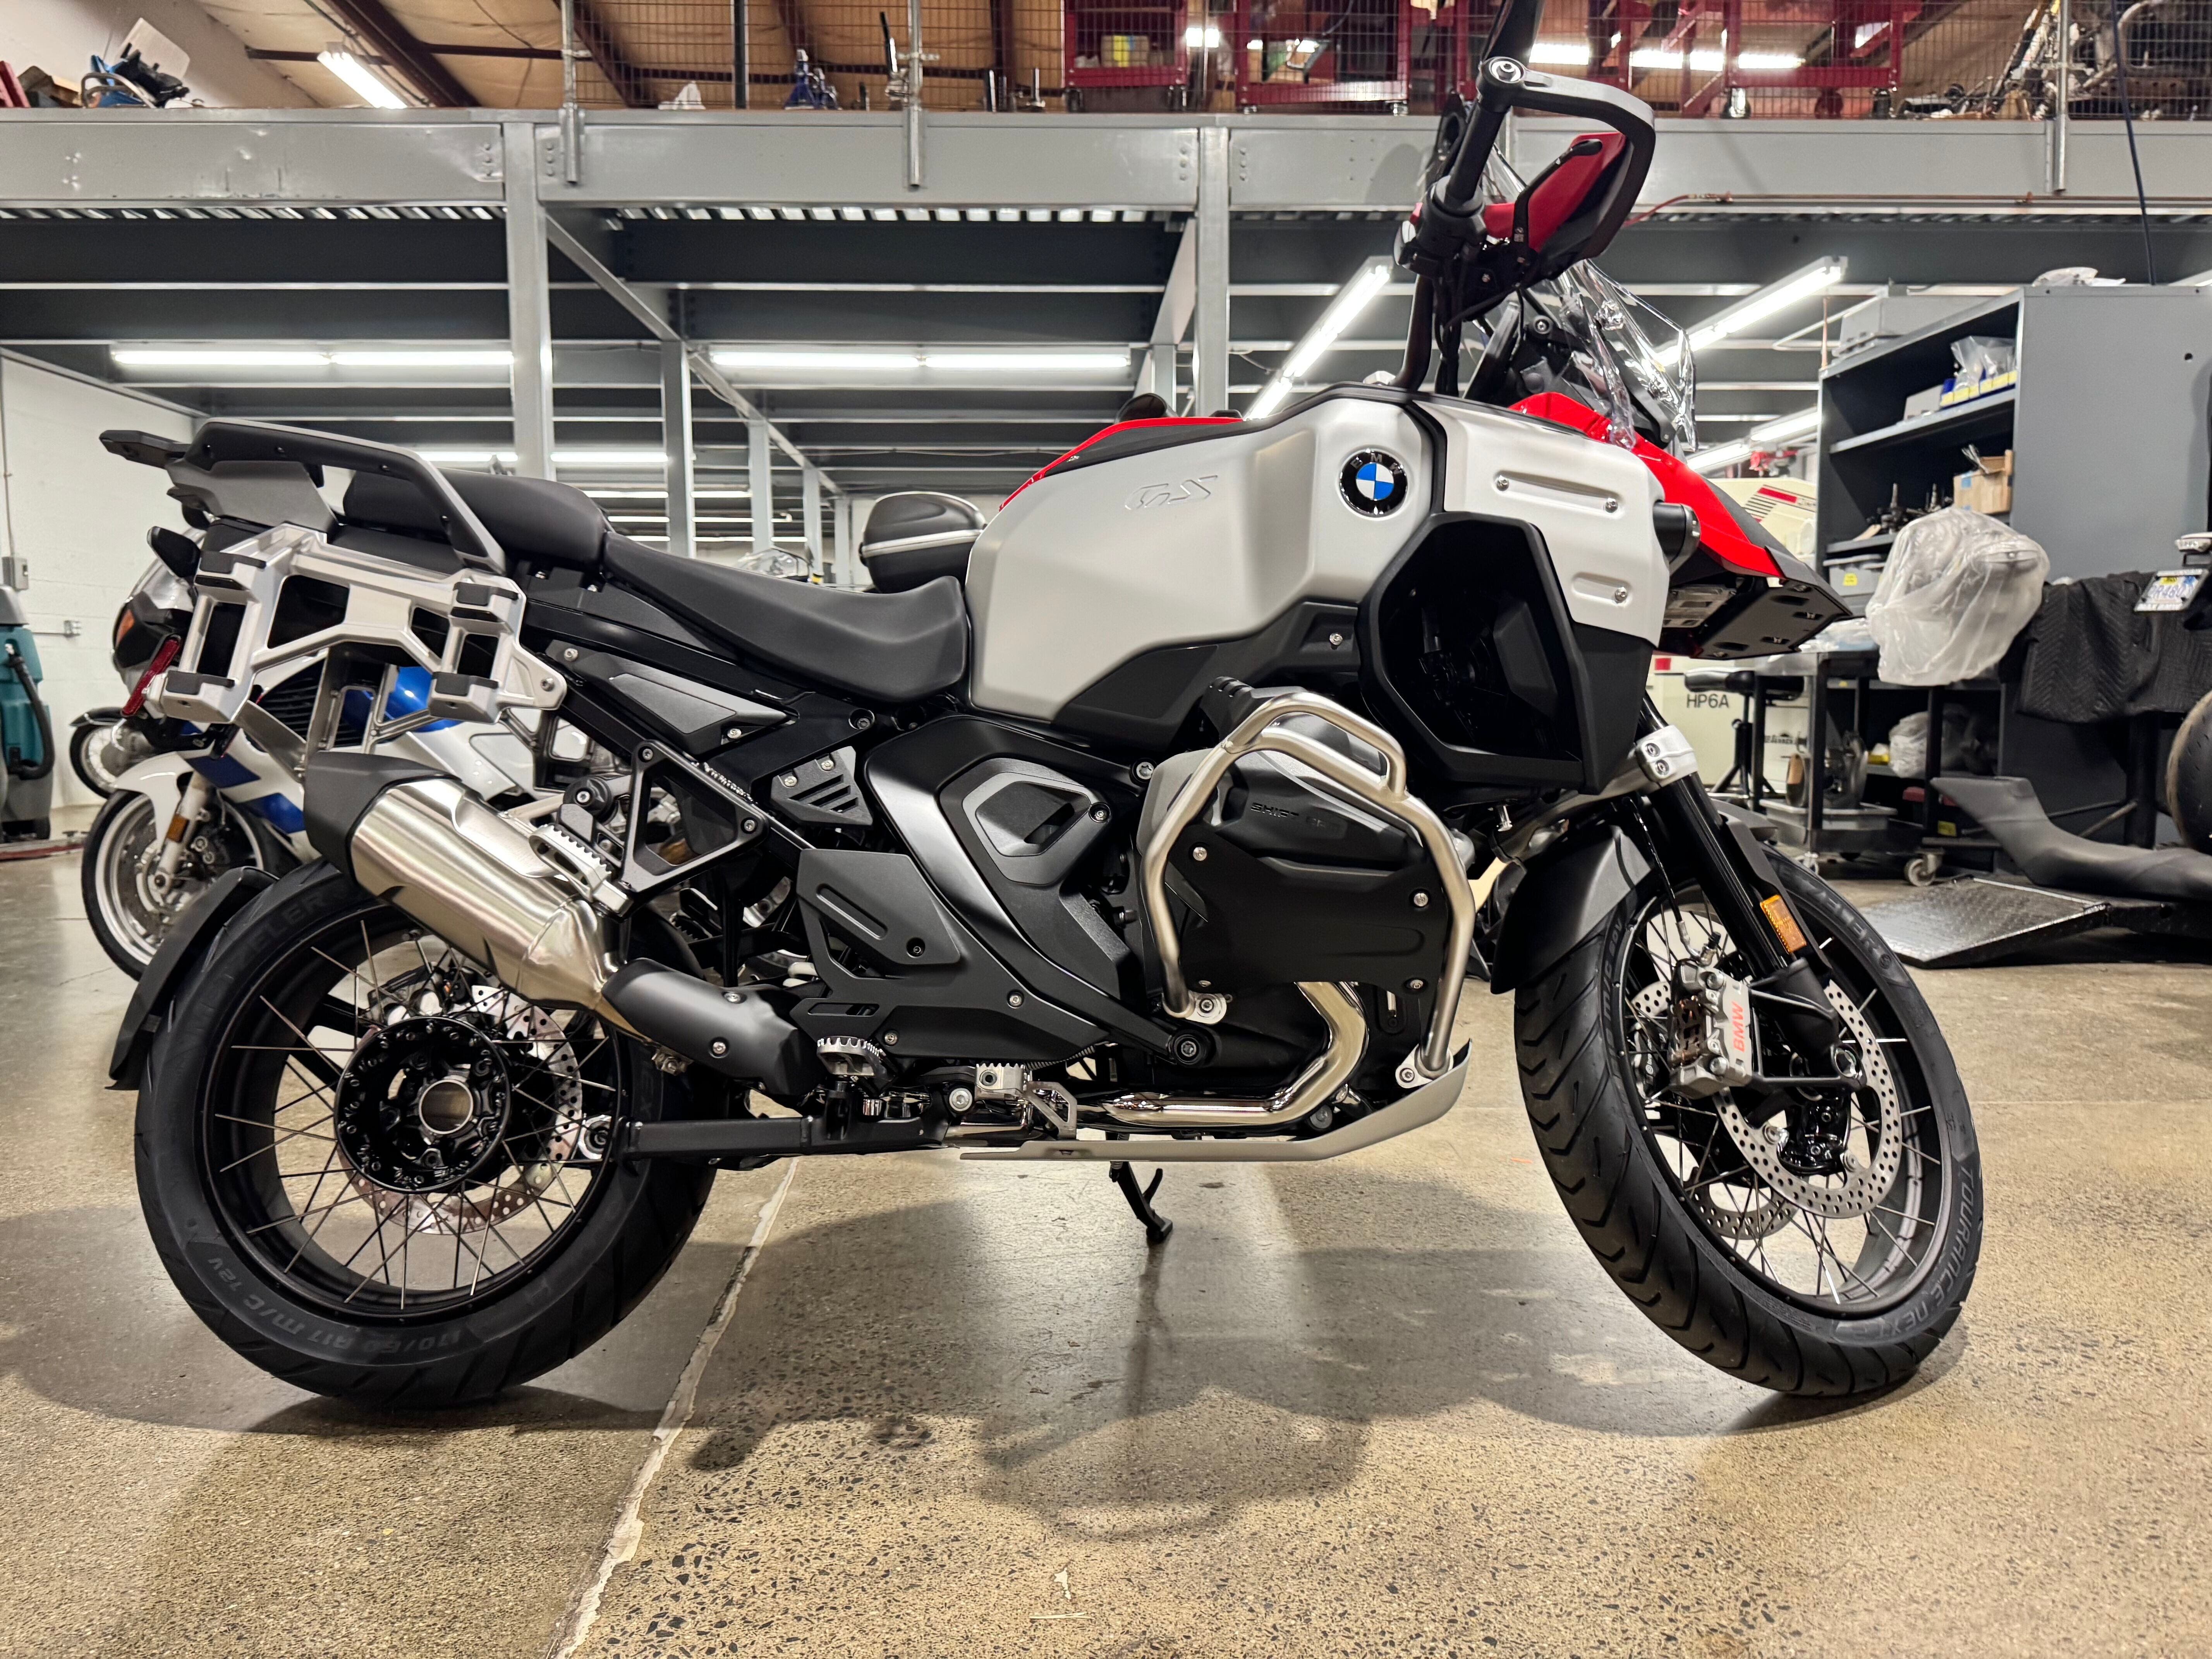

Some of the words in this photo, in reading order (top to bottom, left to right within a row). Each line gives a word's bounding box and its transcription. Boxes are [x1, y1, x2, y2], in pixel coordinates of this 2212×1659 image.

[1350, 453, 1402, 475] BMW
[1125, 475, 1218, 510] GS
[1686, 694, 1729, 709] HP6A
[1732, 1001, 1745, 1053] BMW
[1931, 1166, 1974, 1307] TOURANCE
